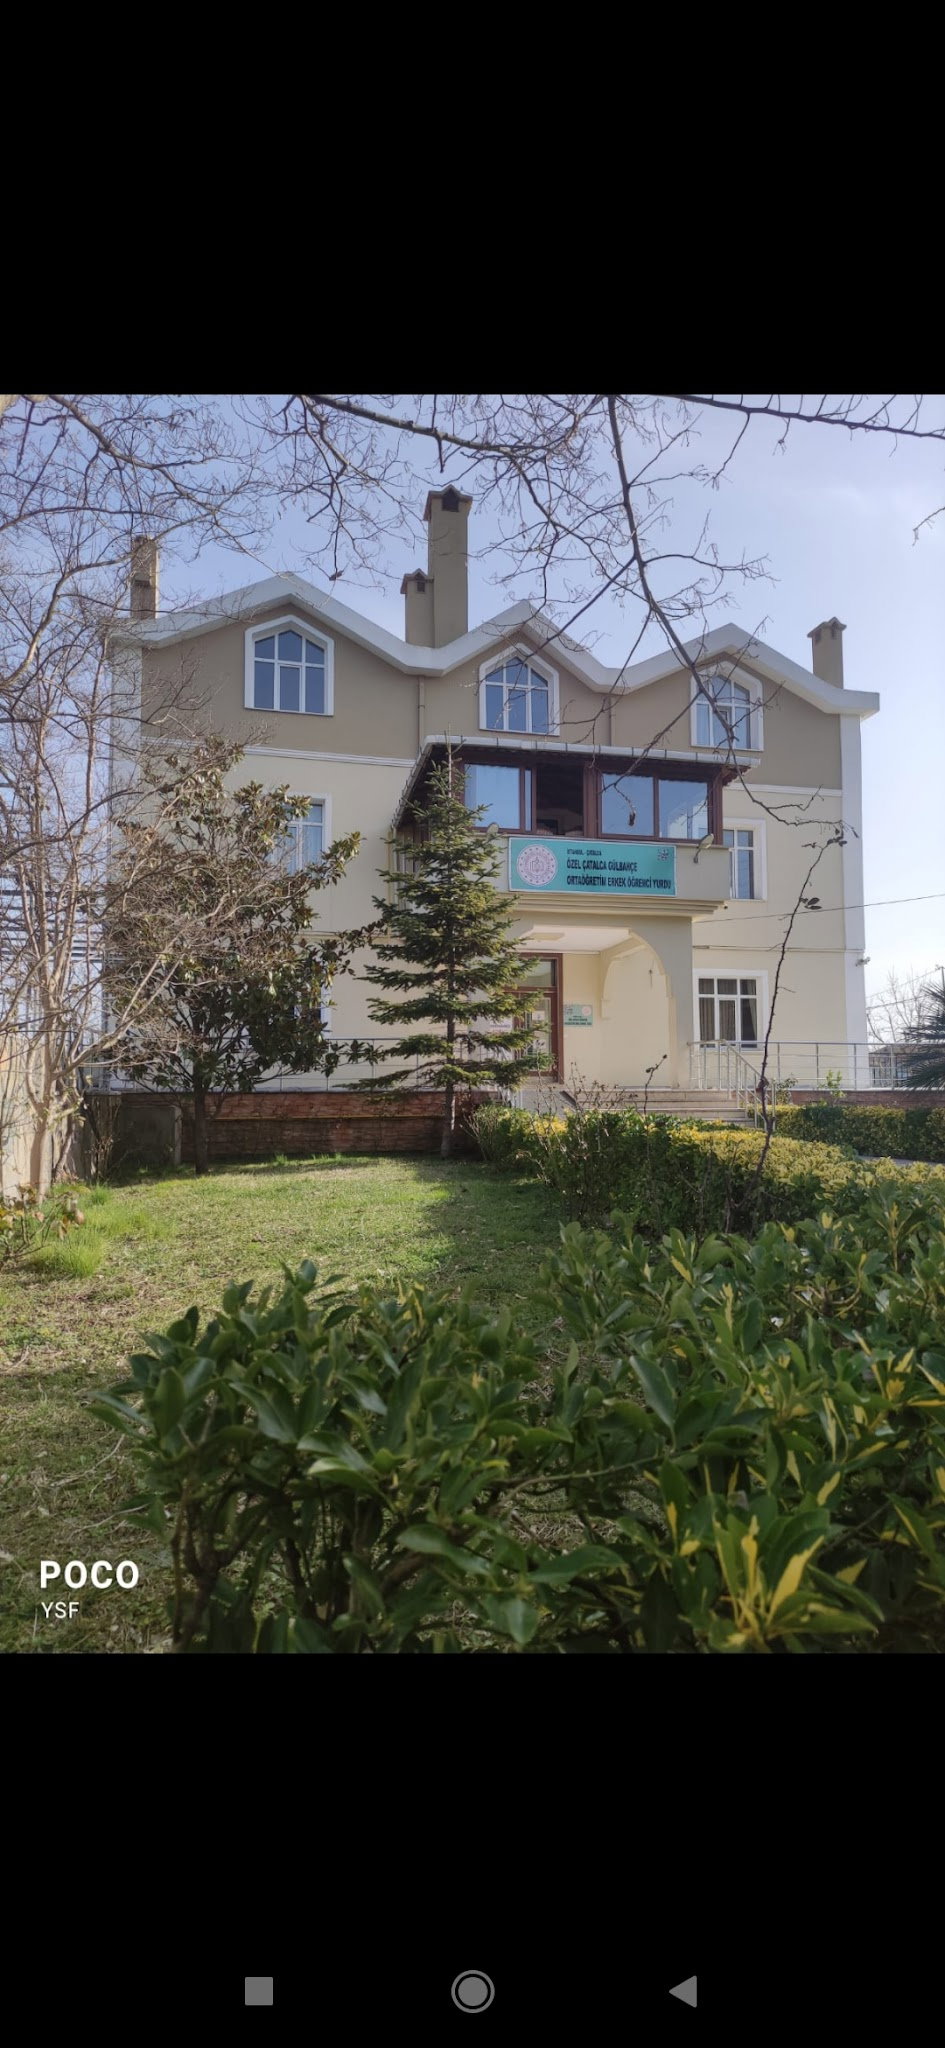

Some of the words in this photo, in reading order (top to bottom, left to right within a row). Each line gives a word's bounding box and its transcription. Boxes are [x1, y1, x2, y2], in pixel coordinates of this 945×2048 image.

[567, 857, 581, 869] ÖZEL
[583, 860, 607, 872] ÇATALCA
[608, 859, 637, 874] GÜLBAHÇE
[608, 877, 626, 888] ERKEK
[652, 879, 672, 889] YURDU
